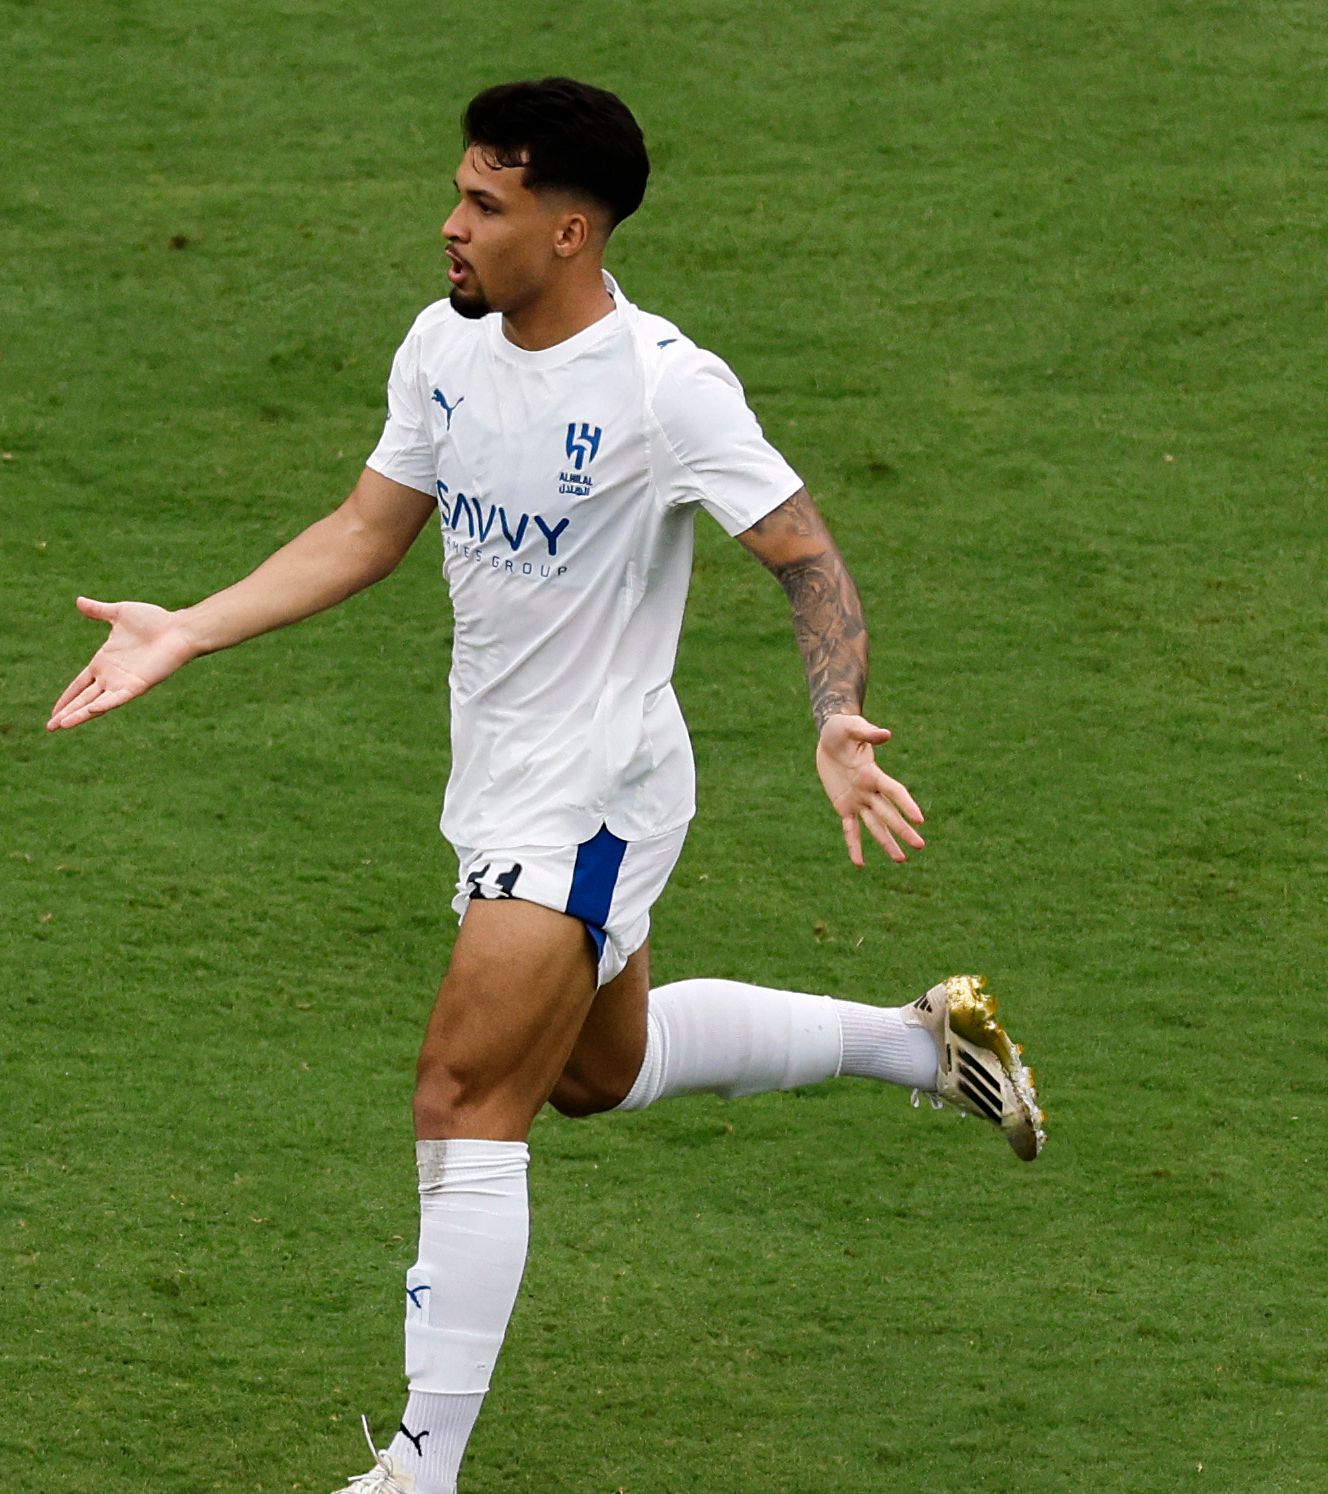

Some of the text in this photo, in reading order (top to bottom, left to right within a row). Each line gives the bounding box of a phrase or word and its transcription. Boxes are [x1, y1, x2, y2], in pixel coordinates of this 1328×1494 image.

[437, 480, 570, 556] SAVVY
[446, 536, 567, 577] AMES GROUP
